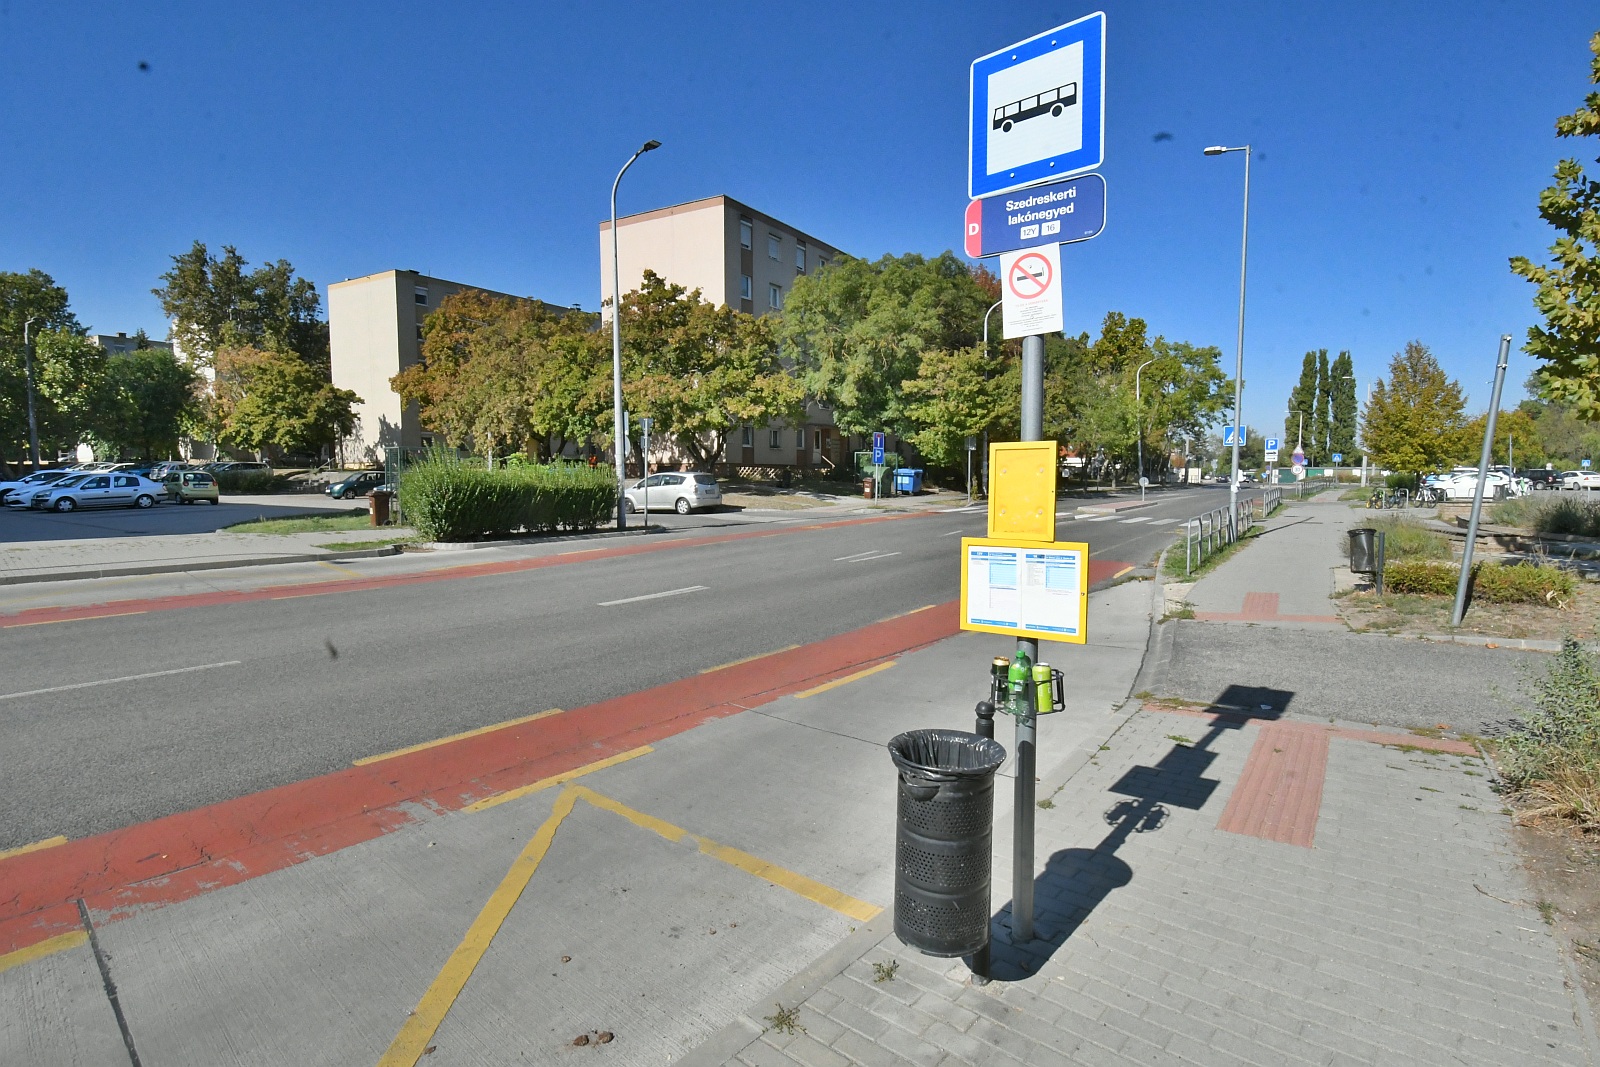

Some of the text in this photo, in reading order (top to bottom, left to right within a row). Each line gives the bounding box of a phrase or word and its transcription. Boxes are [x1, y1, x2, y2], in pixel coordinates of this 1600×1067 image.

[1006, 187, 1077, 211] Szedreskerti
[1008, 203, 1074, 225] lakónegyed
[968, 223, 980, 236] D
[1023, 224, 1055, 236] 12Y 16
[1267, 440, 1276, 449] P
[875, 450, 882, 462] P
